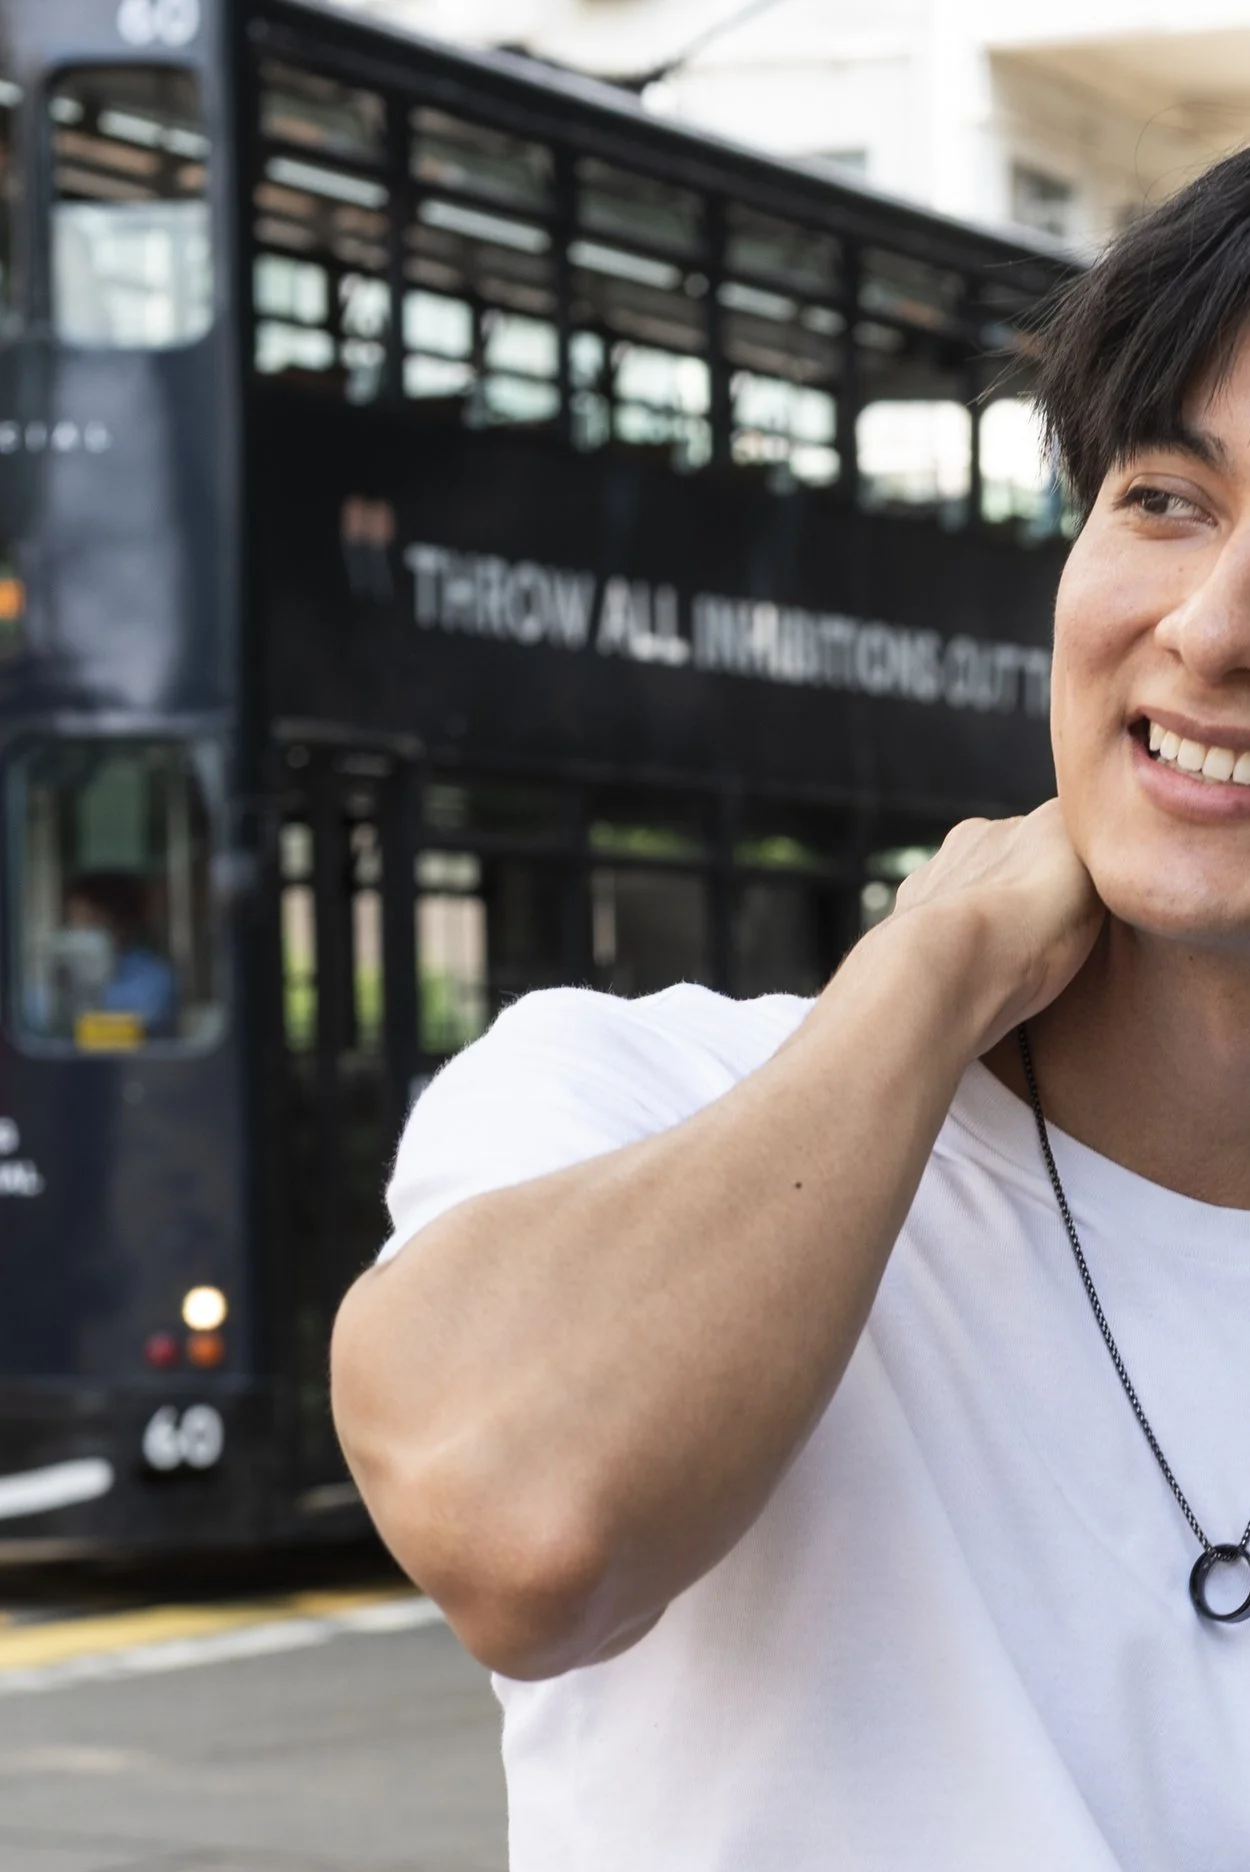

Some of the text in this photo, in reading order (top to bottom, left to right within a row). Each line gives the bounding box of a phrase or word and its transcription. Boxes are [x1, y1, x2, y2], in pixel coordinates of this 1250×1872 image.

[403, 541, 597, 651] THROW
[596, 574, 690, 666] ALL
[691, 593, 942, 704] INHIBITIONS
[141, 1402, 225, 1471] 60
